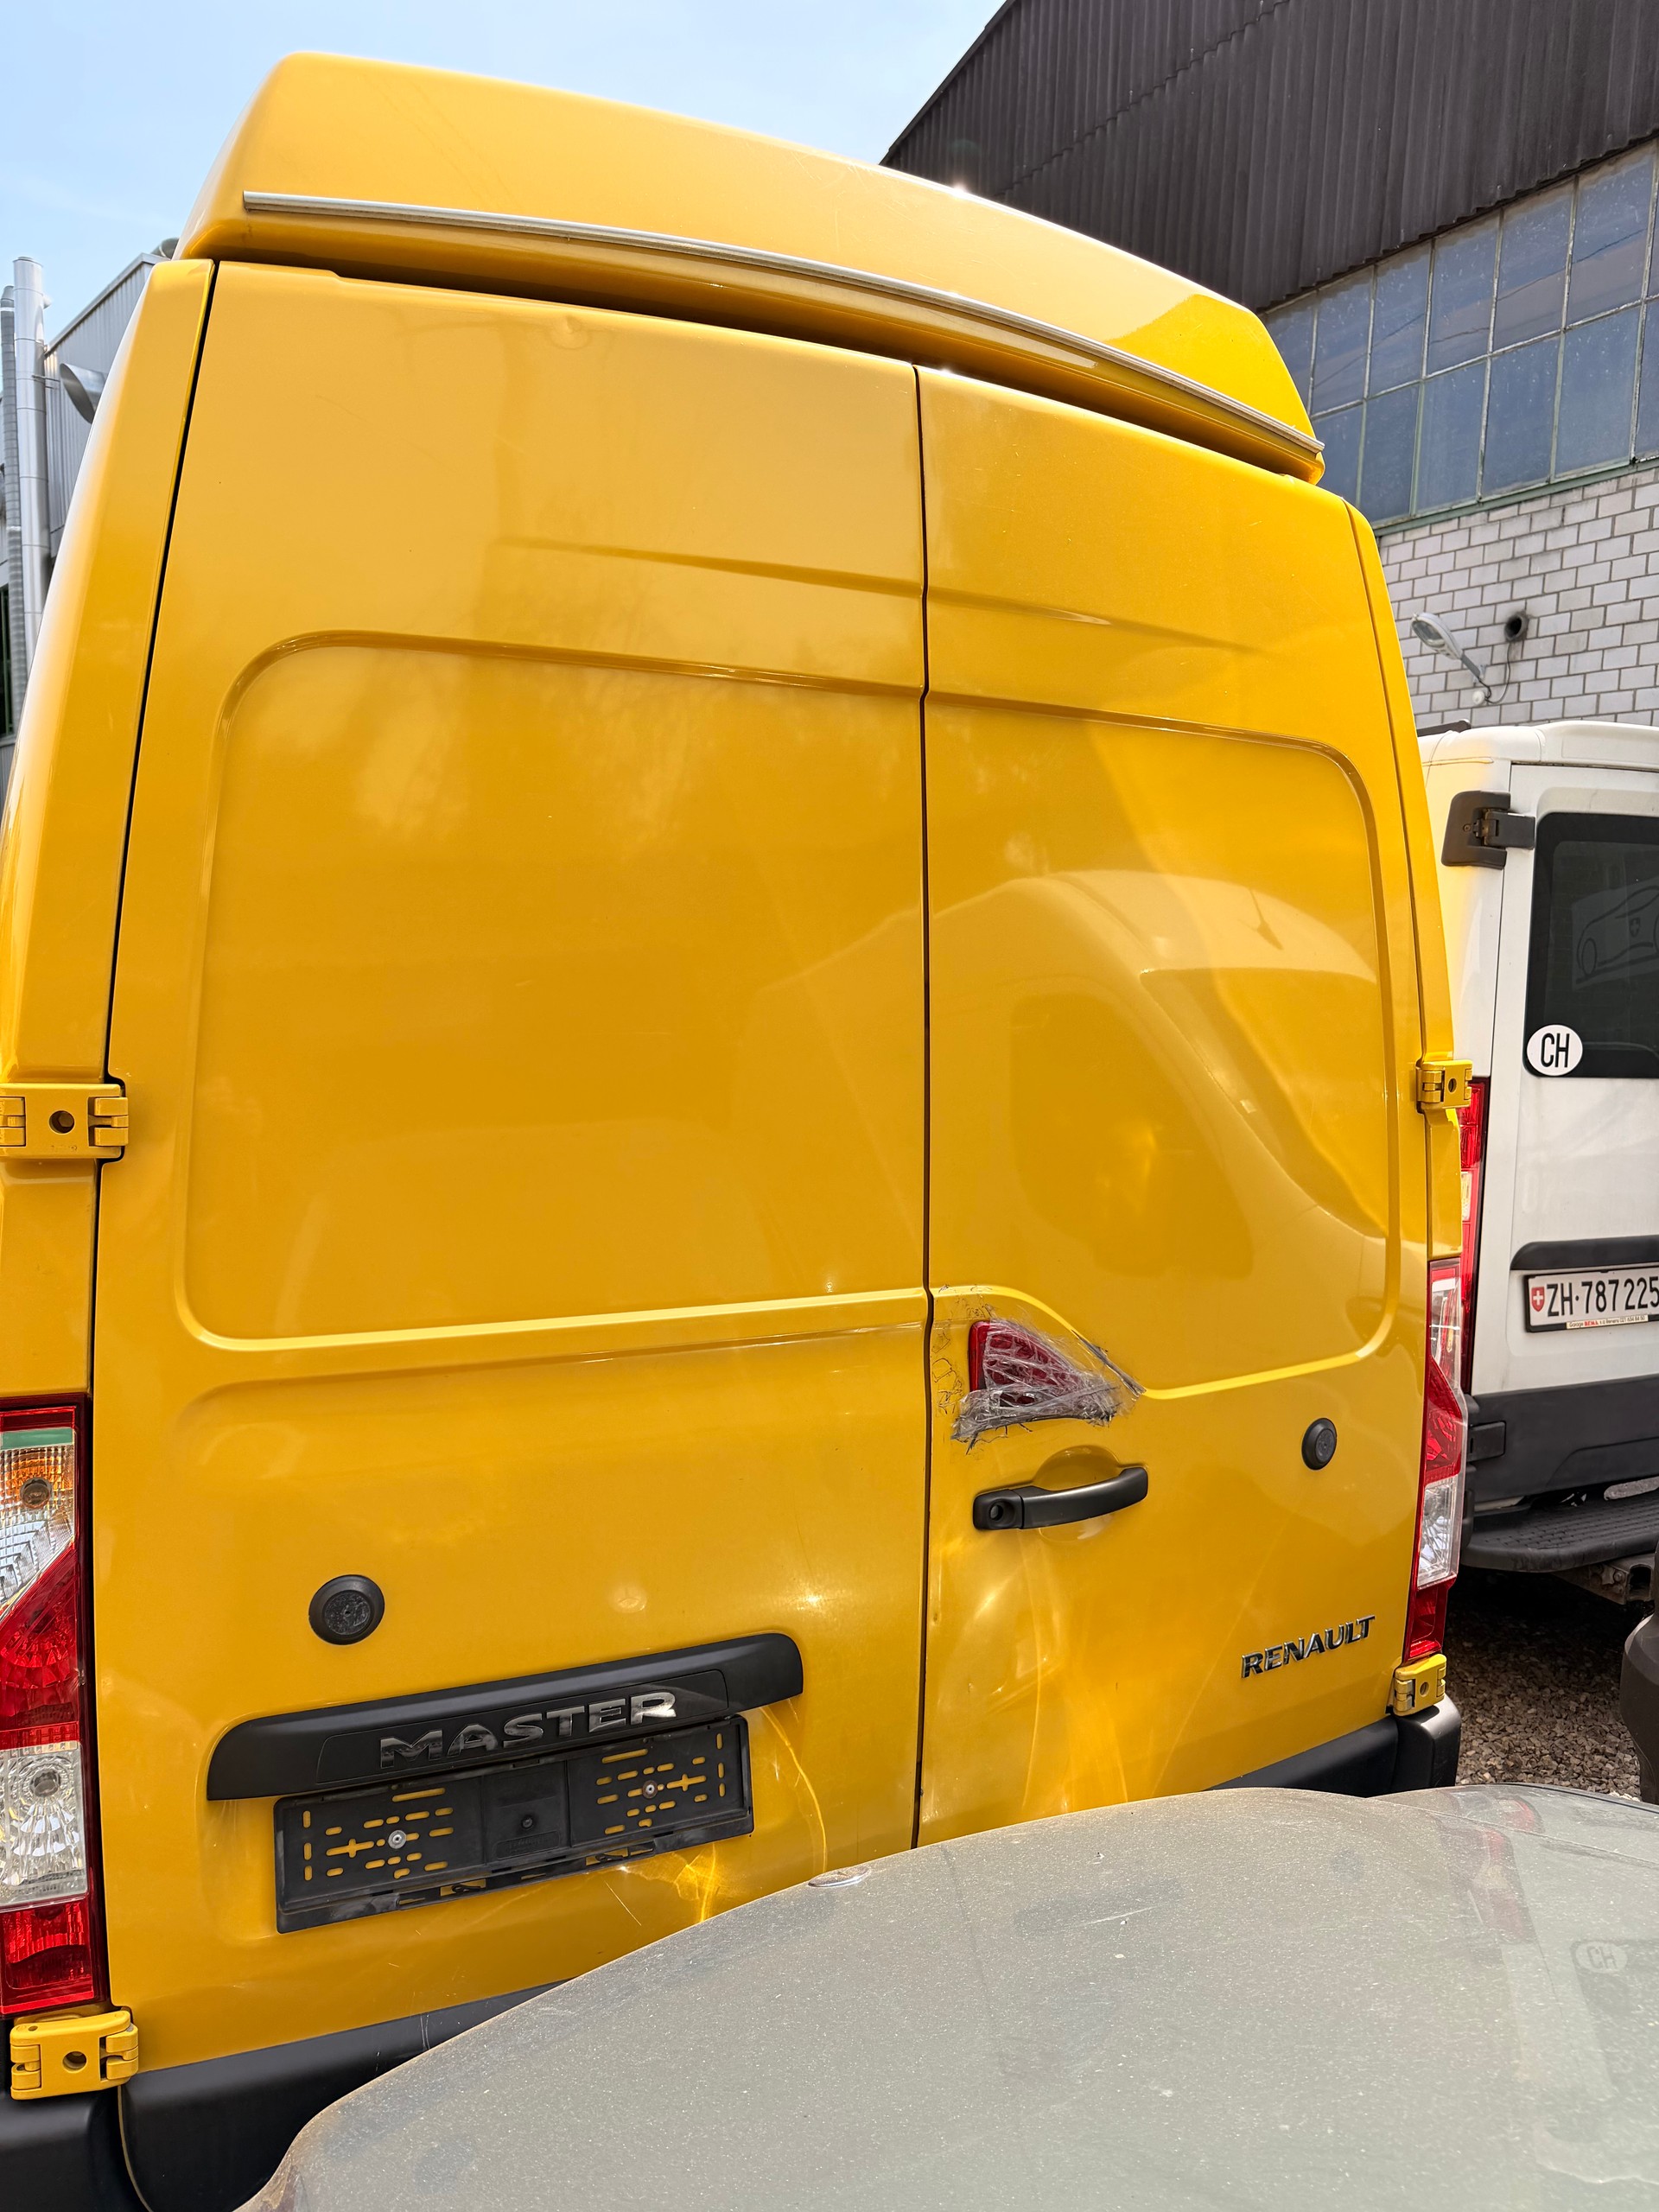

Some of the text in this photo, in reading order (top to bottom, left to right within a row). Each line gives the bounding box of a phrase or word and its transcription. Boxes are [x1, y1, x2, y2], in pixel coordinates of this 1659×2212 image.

[1540, 1033, 1570, 1069] CH
[1241, 1614, 1376, 1679] RENAULT
[380, 1691, 677, 1769] MASTER
